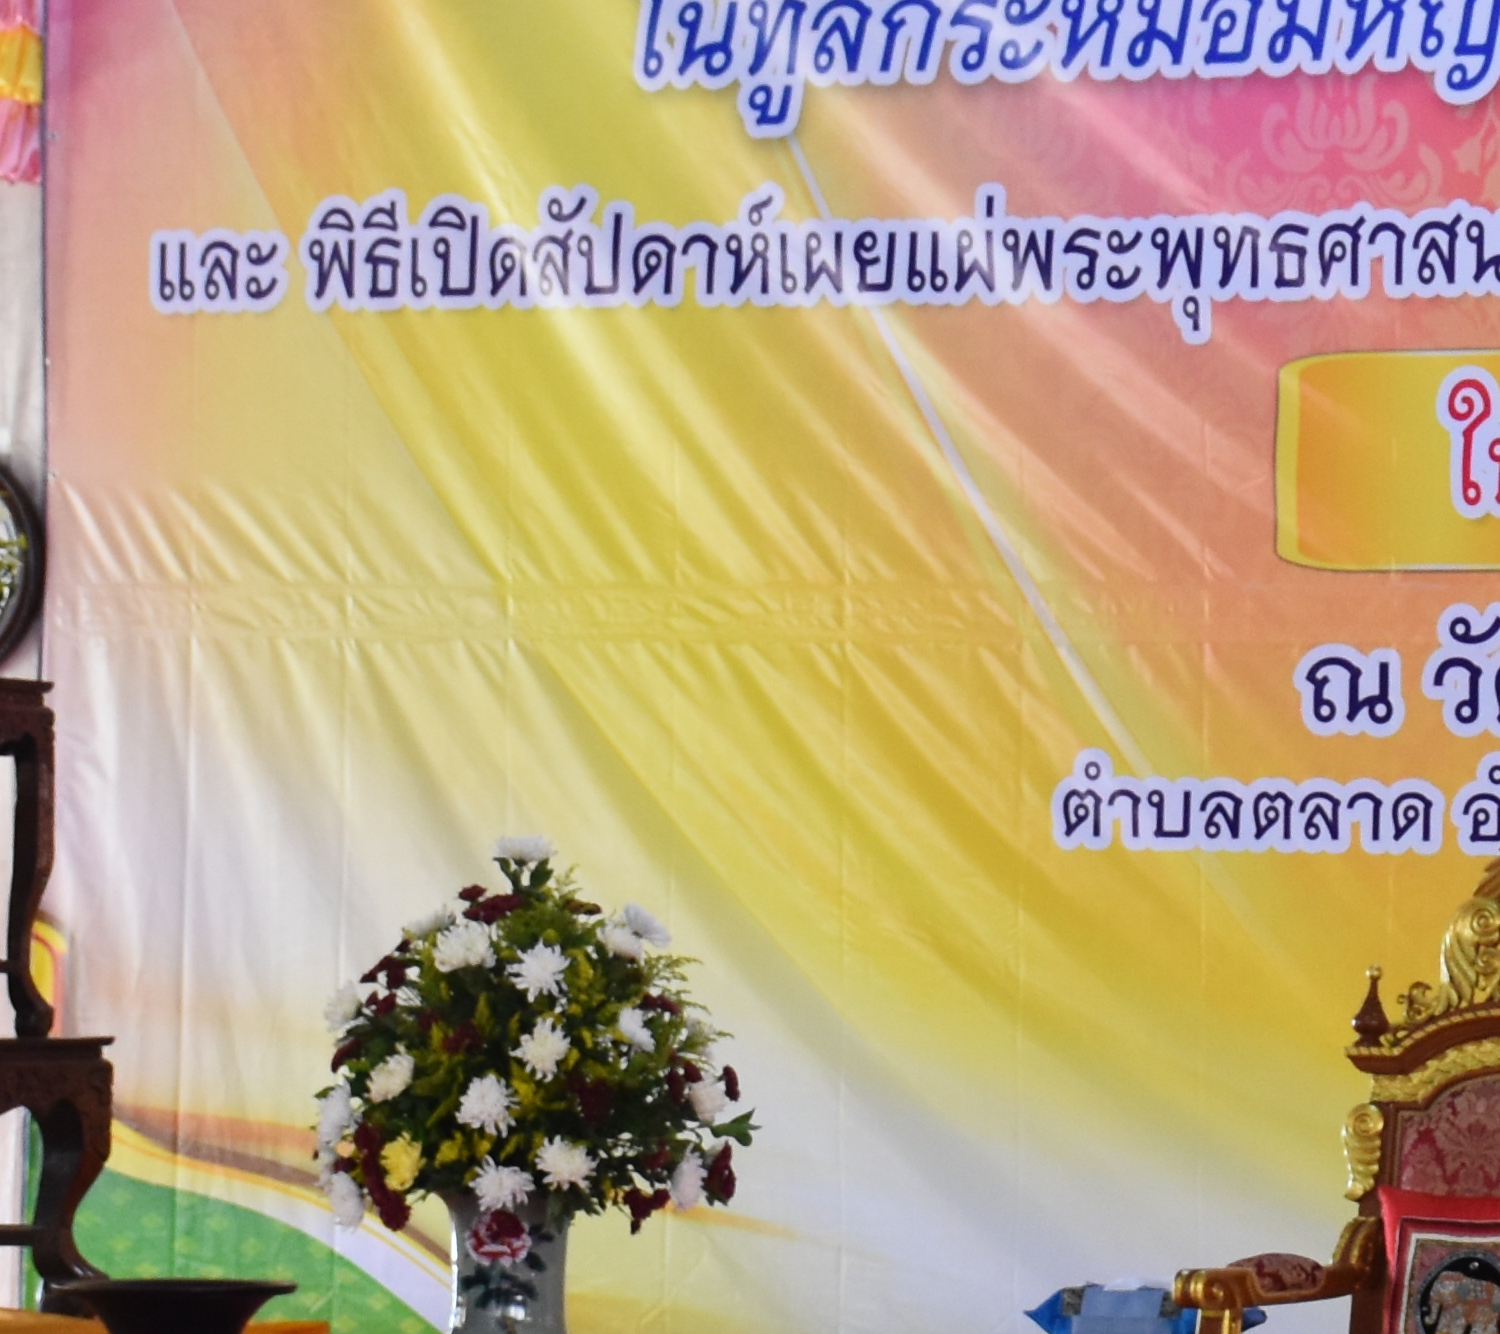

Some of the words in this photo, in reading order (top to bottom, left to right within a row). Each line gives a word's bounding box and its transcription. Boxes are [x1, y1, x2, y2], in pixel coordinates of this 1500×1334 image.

[159, 240, 278, 301] และ
[1305, 655, 1393, 725] ณ
[1062, 761, 1434, 841] ตำบลตลาด
